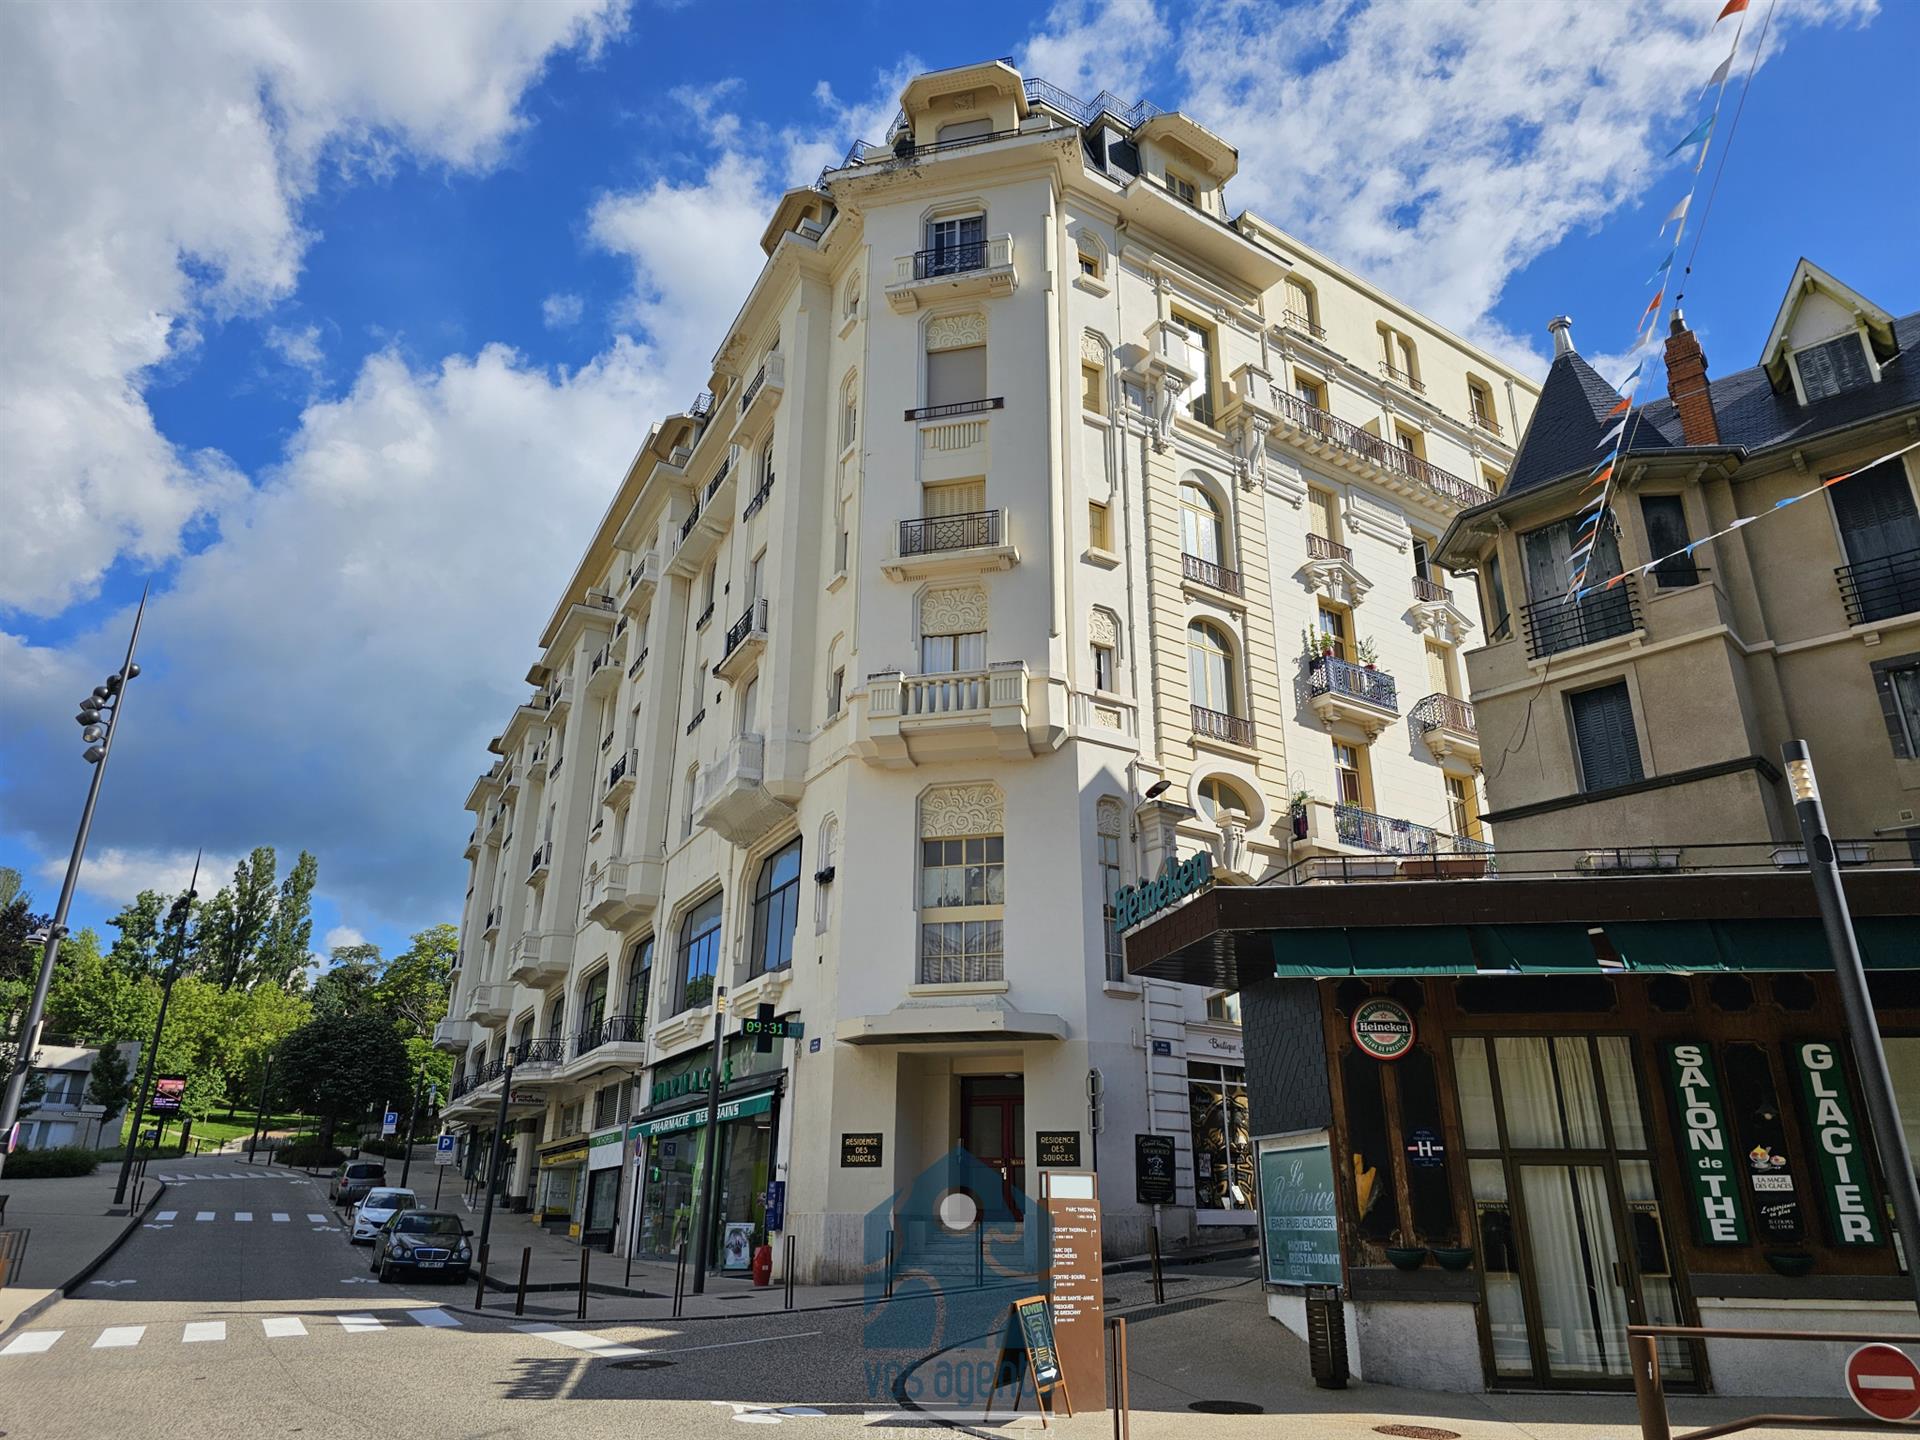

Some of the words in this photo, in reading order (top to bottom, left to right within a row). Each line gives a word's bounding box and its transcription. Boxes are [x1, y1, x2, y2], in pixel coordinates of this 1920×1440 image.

[1115, 850, 1212, 933] Heineken
[746, 1021, 783, 1035] 09:31
[1360, 1022, 1409, 1032] Heineken
[652, 1058, 733, 1103] PHARMACE
[1674, 1046, 1723, 1150] SALON
[650, 1114, 689, 1133] PHARMACIE
[695, 1110, 708, 1123] DES
[1051, 1145, 1064, 1153] DES
[1801, 1043, 1874, 1242] GLACIER
[846, 1154, 877, 1163] SOURCES
[1042, 1154, 1074, 1162] SOURCES
[1698, 1157, 1723, 1169] de
[1700, 1175, 1738, 1241] THE
[1289, 1253, 1340, 1265] RESTAURANT
[1290, 1265, 1312, 1277] GRILL
